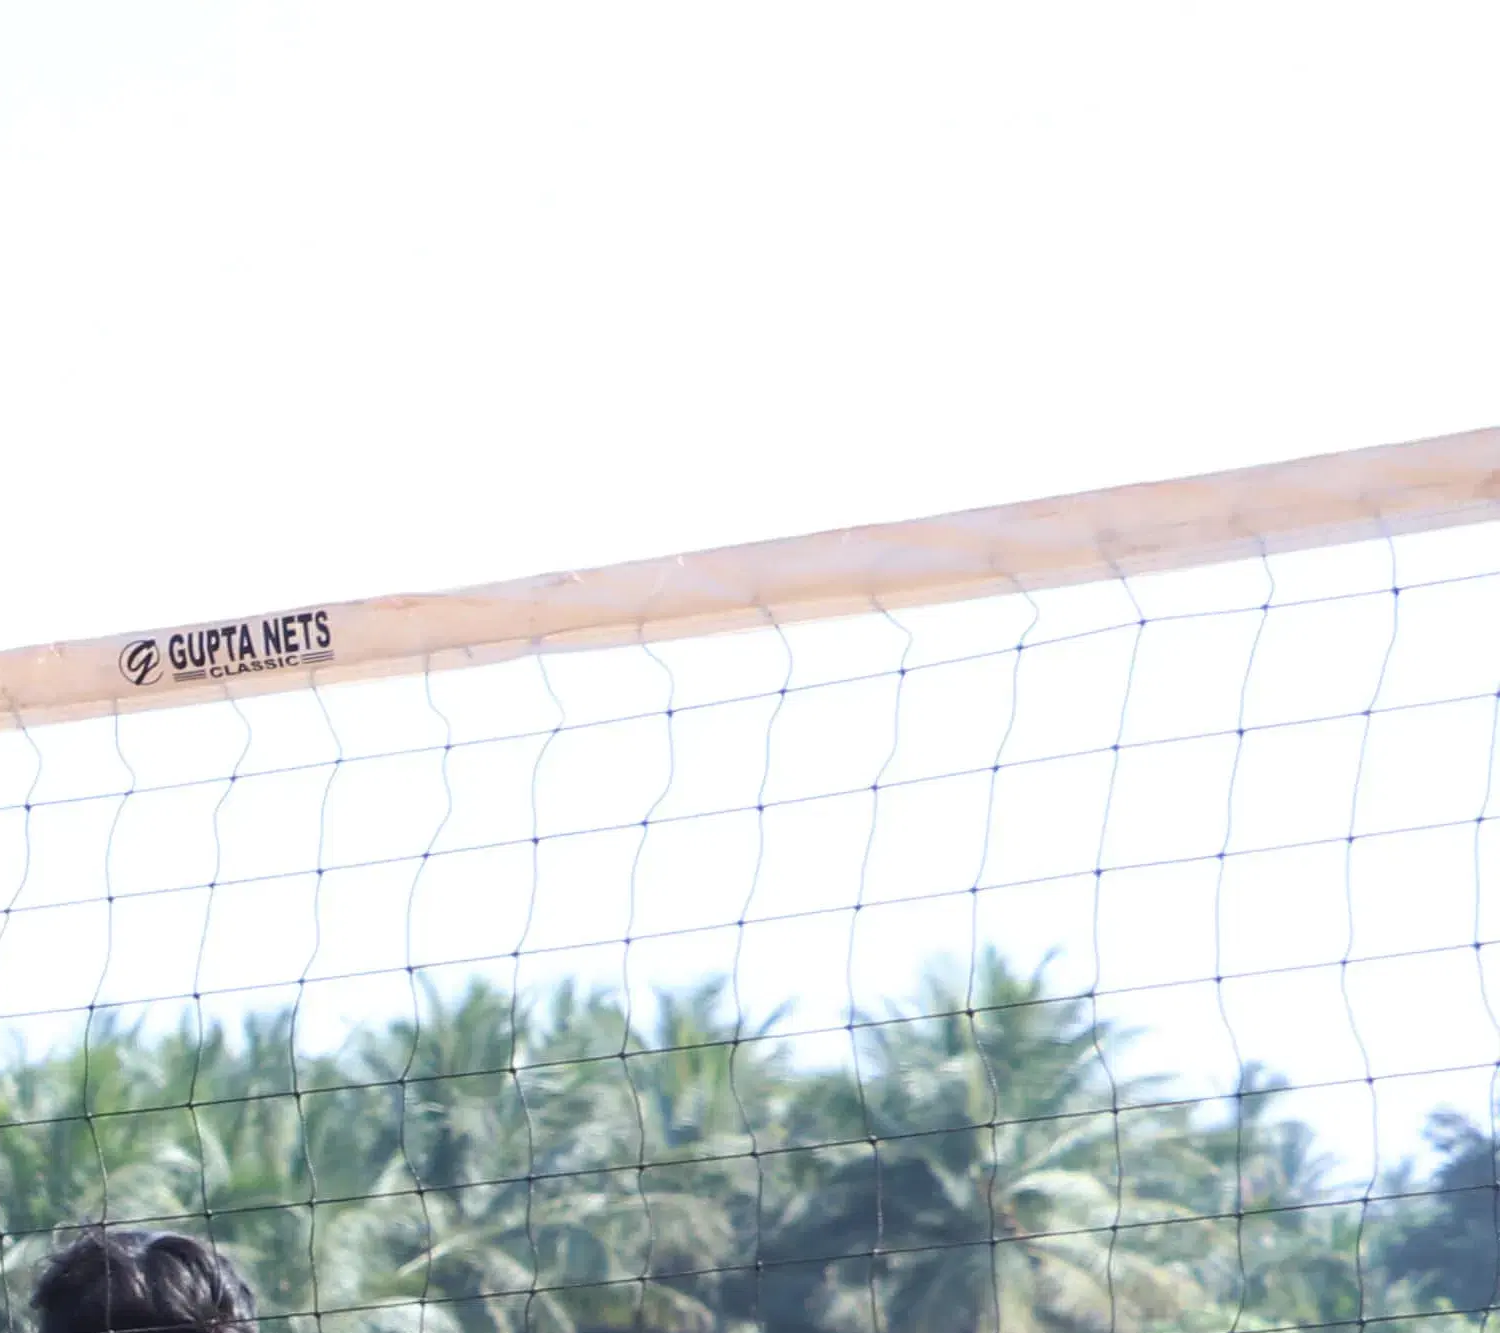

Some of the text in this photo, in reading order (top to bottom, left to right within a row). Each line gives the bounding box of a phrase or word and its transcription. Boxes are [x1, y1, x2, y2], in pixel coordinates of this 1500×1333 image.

[169, 611, 331, 670] GUPTA NETS
[209, 655, 300, 678] CLASSIC
